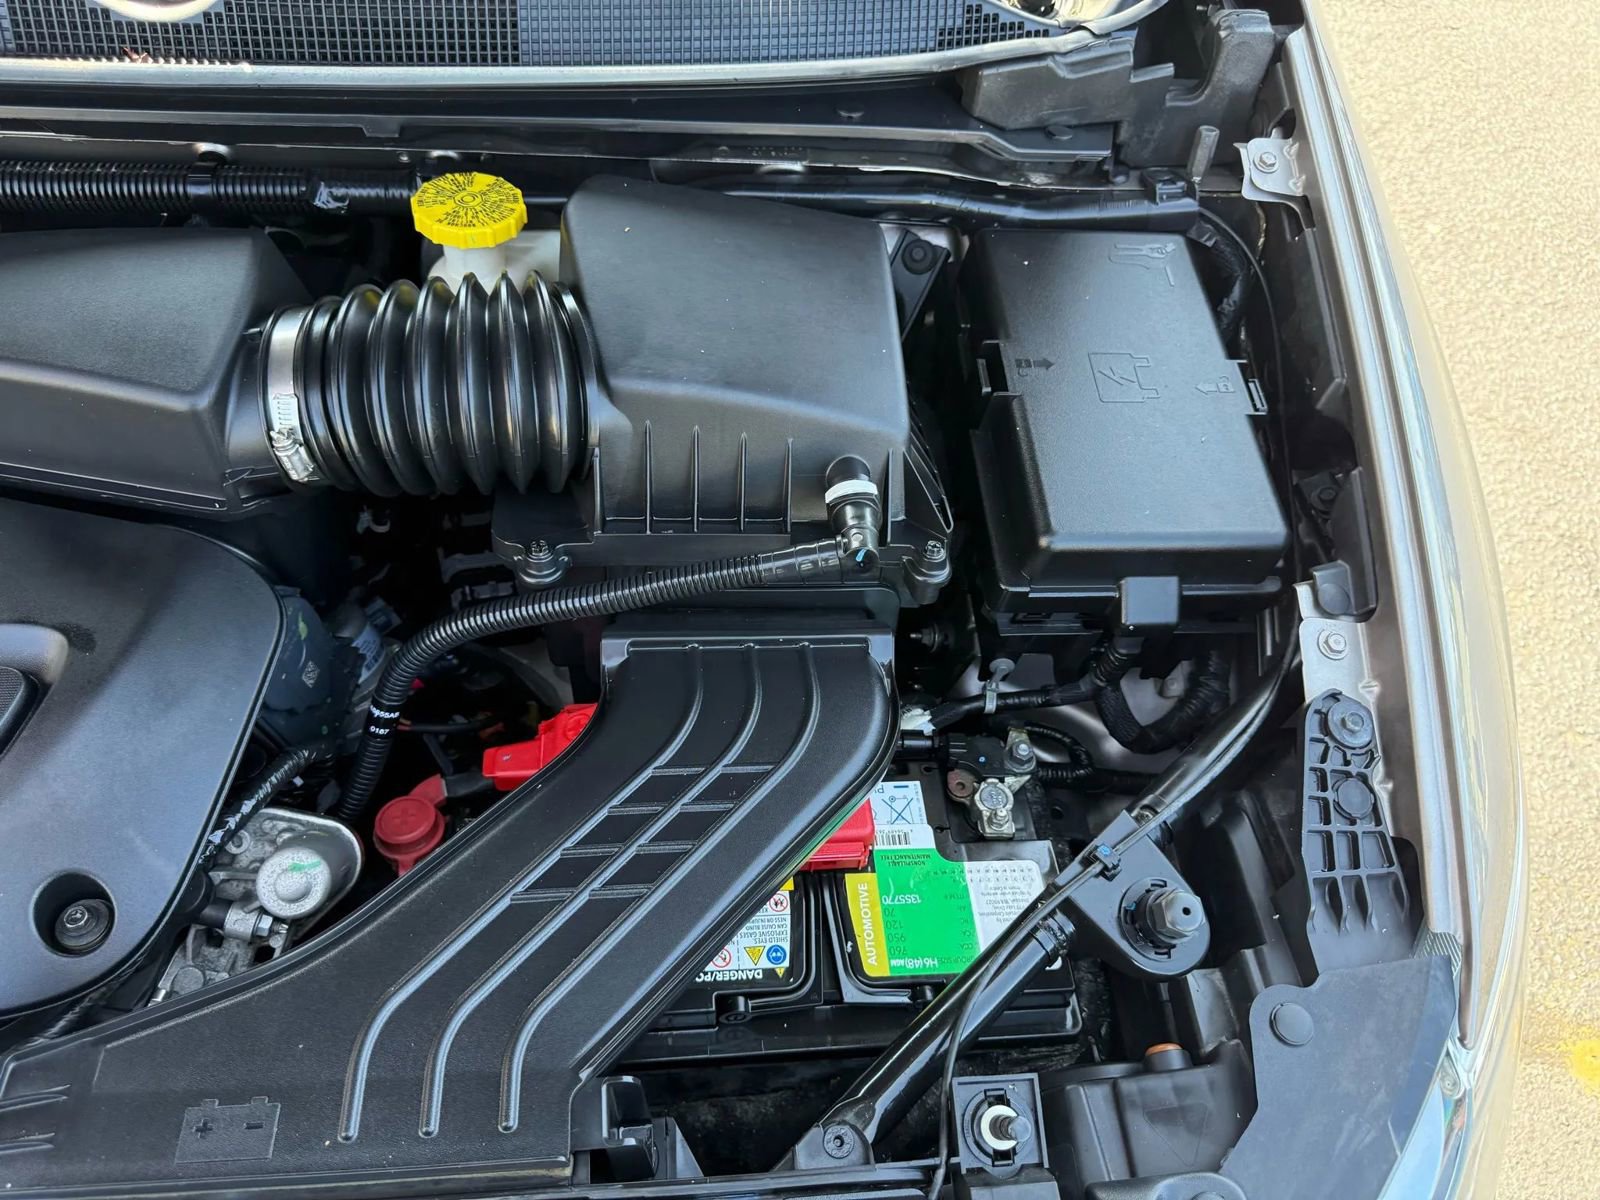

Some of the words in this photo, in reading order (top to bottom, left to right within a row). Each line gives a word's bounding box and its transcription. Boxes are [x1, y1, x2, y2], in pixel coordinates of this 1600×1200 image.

[882, 894, 921, 904] 1355770
[884, 907, 895, 917] 70
[858, 882, 878, 965] AUTOMOTIVE
[885, 920, 904, 929] 120
[888, 933, 905, 943] 950
[889, 946, 907, 955] 760
